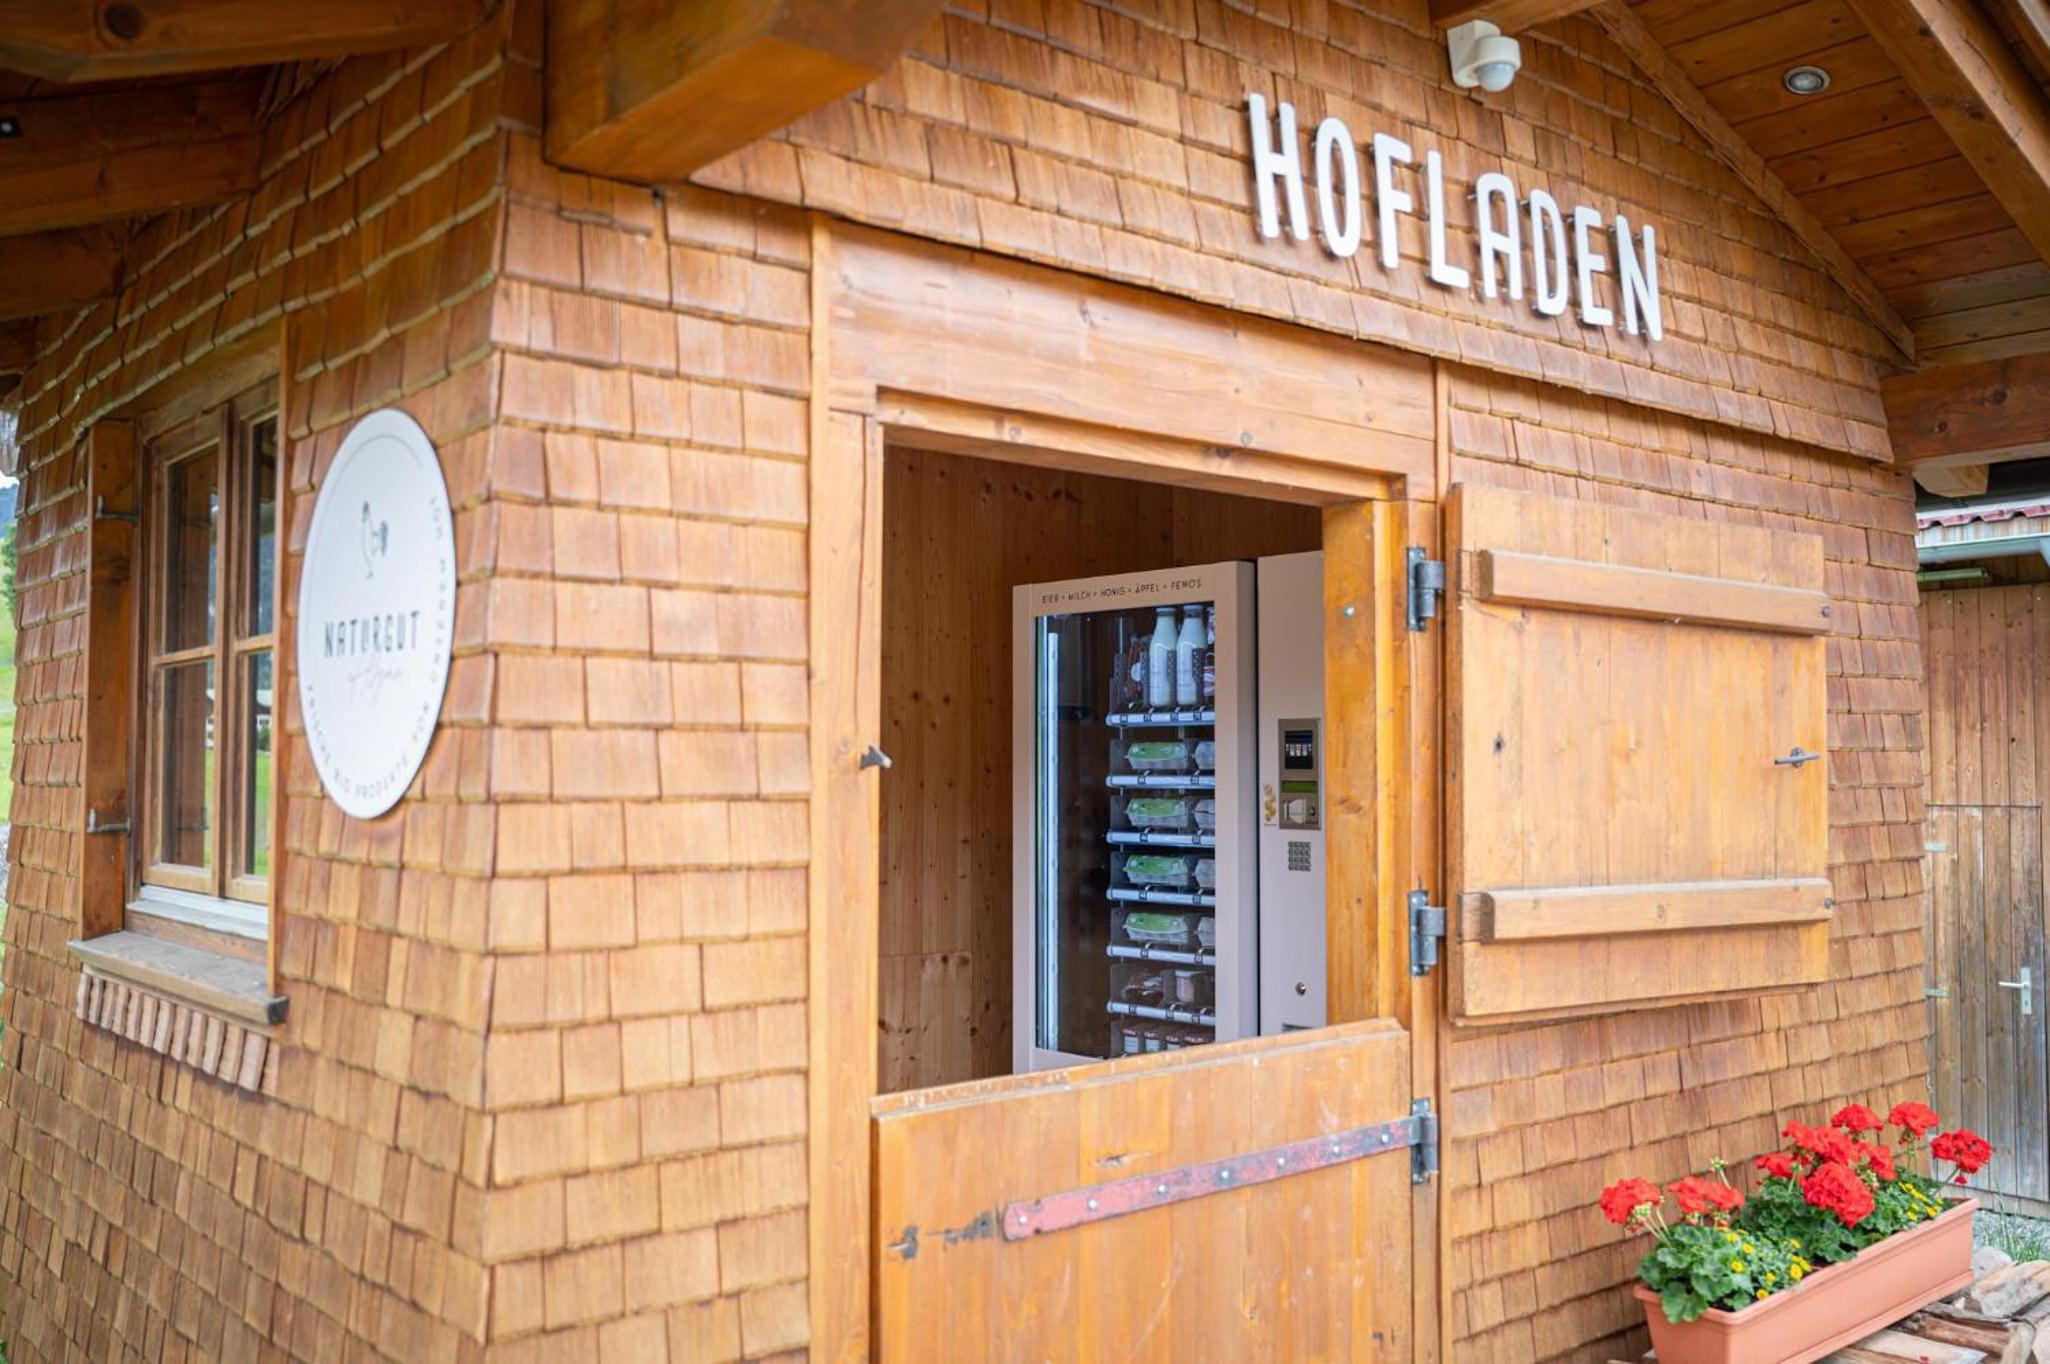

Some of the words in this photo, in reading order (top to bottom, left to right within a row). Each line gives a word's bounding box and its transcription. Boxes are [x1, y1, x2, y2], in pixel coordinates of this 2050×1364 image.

[1248, 92, 1663, 342] HOFLADEN
[1041, 593, 1059, 604] EIER
[1067, 590, 1092, 601] MILCH
[1100, 586, 1126, 597] HONIG
[1134, 582, 1160, 595] ÄPFEL
[323, 609, 420, 658] NATURGUT
